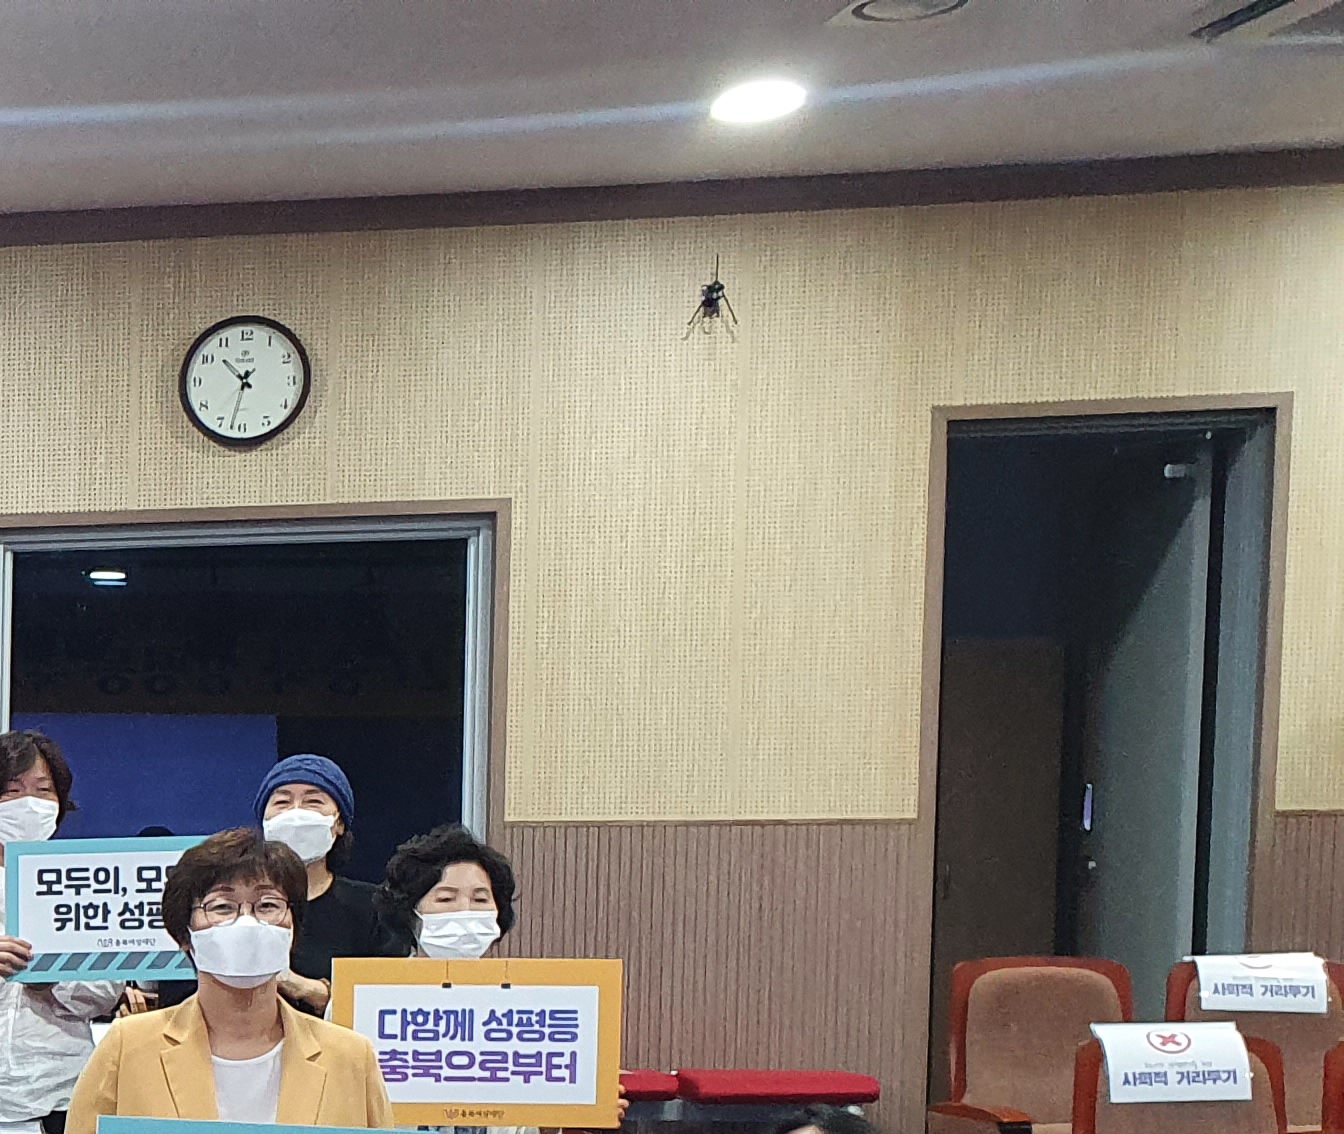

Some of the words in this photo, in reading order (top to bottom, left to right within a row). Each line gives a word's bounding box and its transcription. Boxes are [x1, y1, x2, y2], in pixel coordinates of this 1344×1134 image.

[219, 337, 229, 347] 11
[240, 330, 253, 341] 12
[202, 354, 214, 365] 10
[36, 866, 127, 897] 모두의,
[54, 901, 111, 931] 위한
[377, 1007, 475, 1042] 다함께
[481, 1009, 579, 1044] 성평등
[377, 1051, 577, 1085] 충북으로부터
